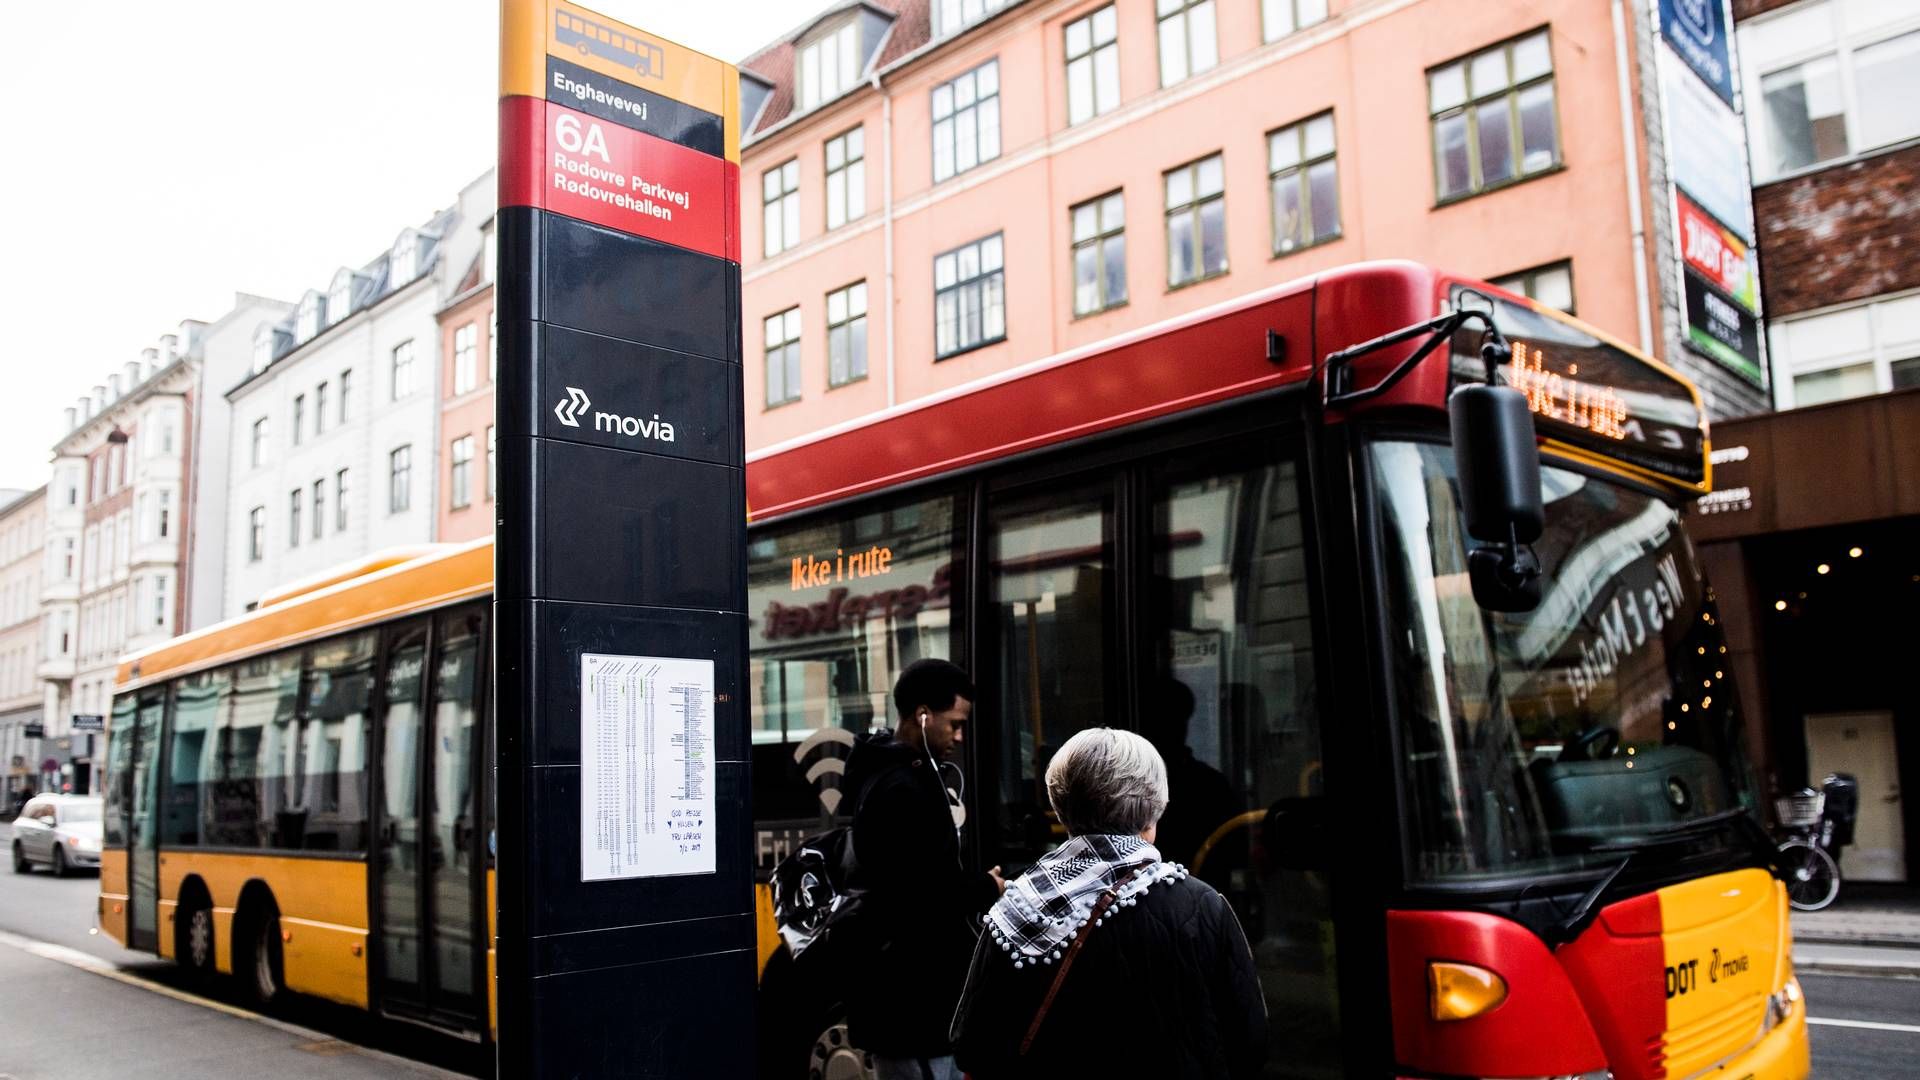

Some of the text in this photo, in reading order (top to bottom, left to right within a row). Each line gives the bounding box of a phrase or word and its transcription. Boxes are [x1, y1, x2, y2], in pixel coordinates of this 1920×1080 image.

[553, 72, 648, 121] Enghavevej
[555, 114, 610, 163] 6A
[554, 152, 689, 210] Rødovre Parkvej
[554, 173, 672, 221] Rødovrehallen
[595, 411, 675, 442] movia
[791, 545, 893, 591] Ikke i rute
[757, 830, 791, 867] Fri
[1664, 959, 1698, 999] DOT
